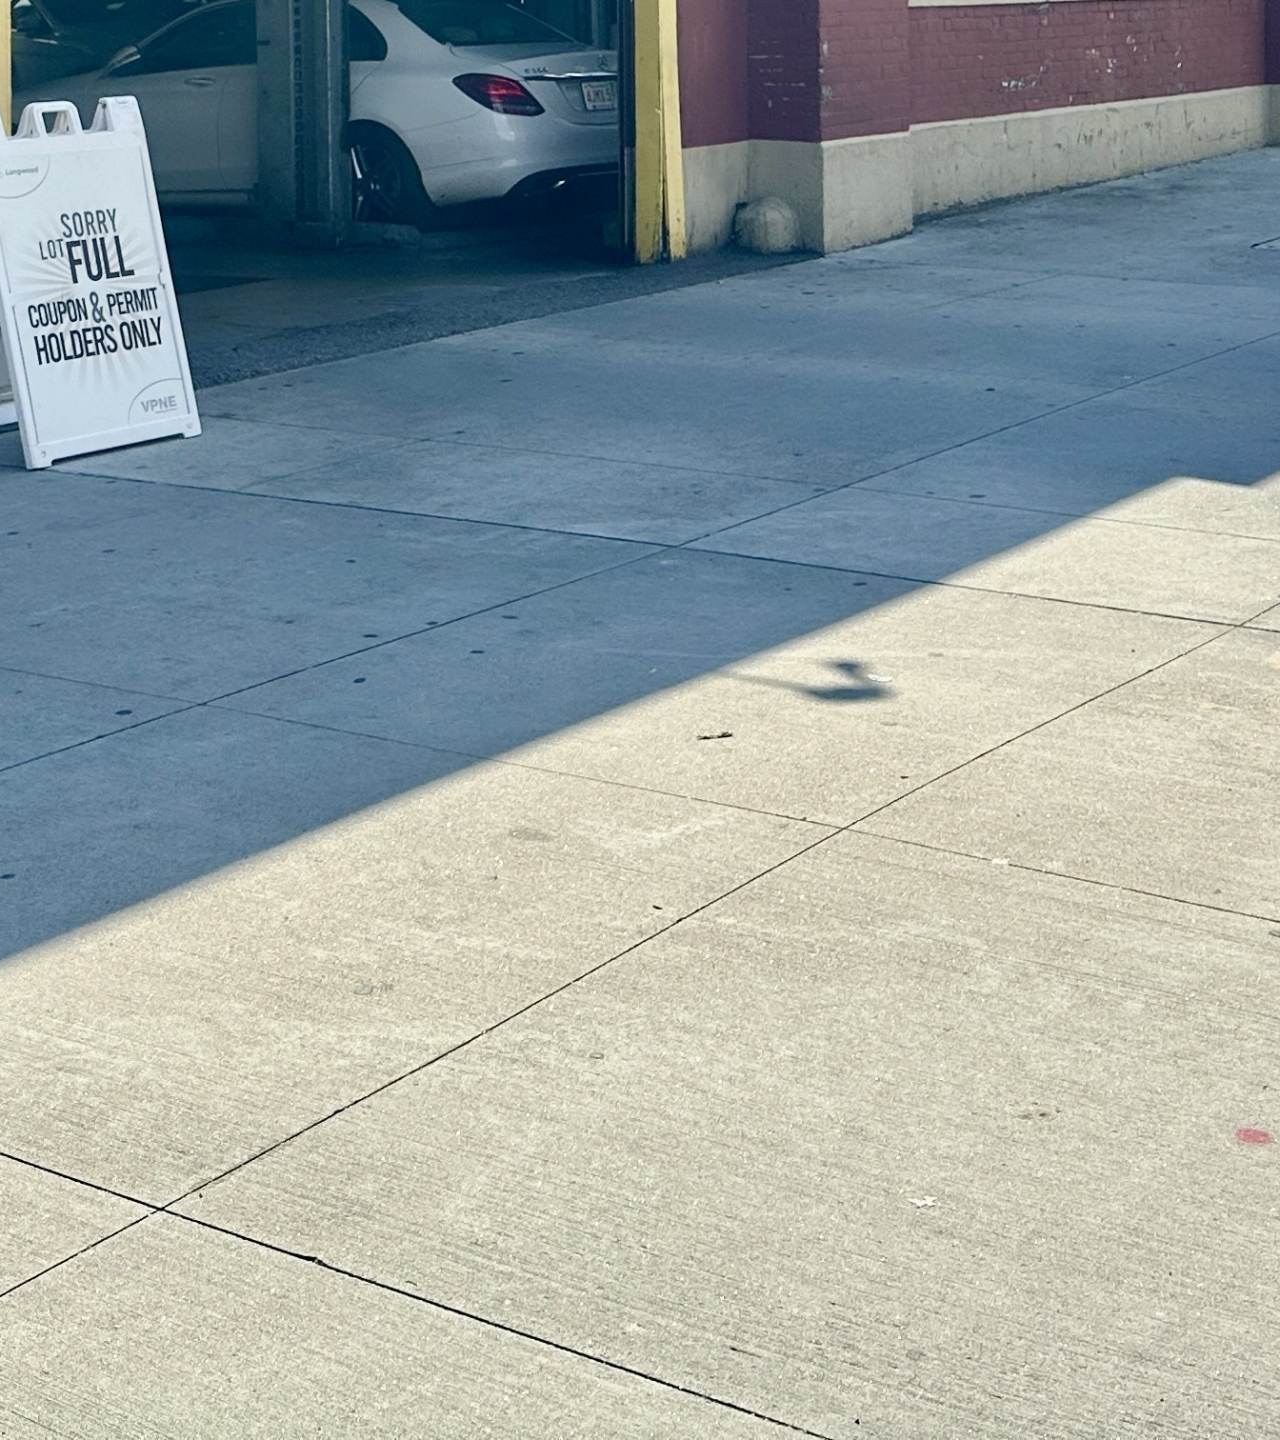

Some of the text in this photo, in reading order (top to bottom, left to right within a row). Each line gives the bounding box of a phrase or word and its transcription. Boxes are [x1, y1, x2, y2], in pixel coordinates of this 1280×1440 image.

[60, 208, 117, 238] SORRY
[38, 235, 135, 284] LOT FULL
[28, 287, 160, 329] COUPON & PERMIT
[34, 317, 162, 365] HOLDERS ONLY
[141, 395, 177, 412] VPNE
